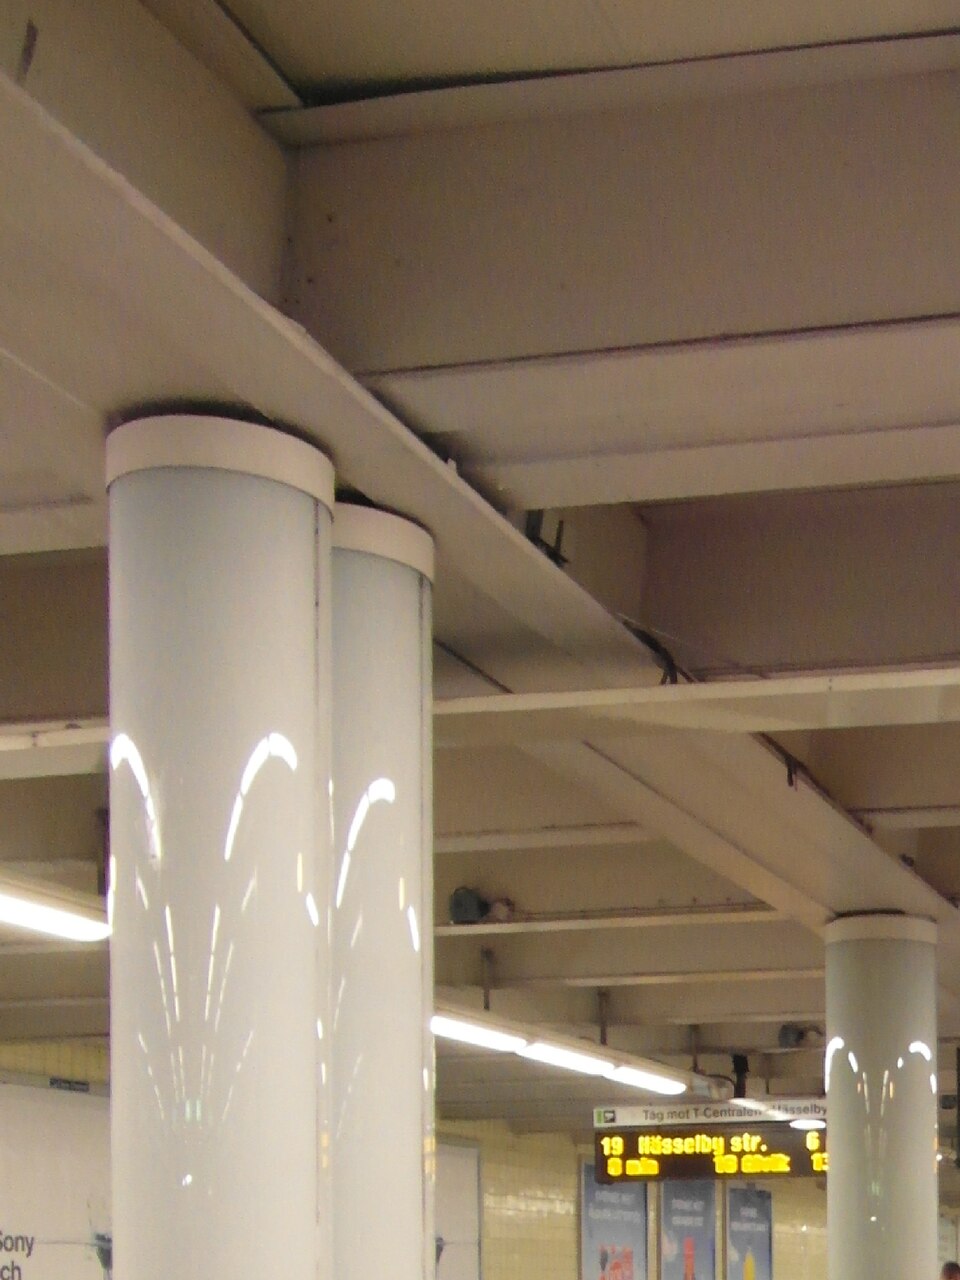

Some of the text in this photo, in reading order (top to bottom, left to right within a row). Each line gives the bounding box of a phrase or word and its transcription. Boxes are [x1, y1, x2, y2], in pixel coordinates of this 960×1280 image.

[600, 1136, 625, 1157] 19
[637, 1133, 725, 1157] Hässelby
[730, 1132, 768, 1153] str.
